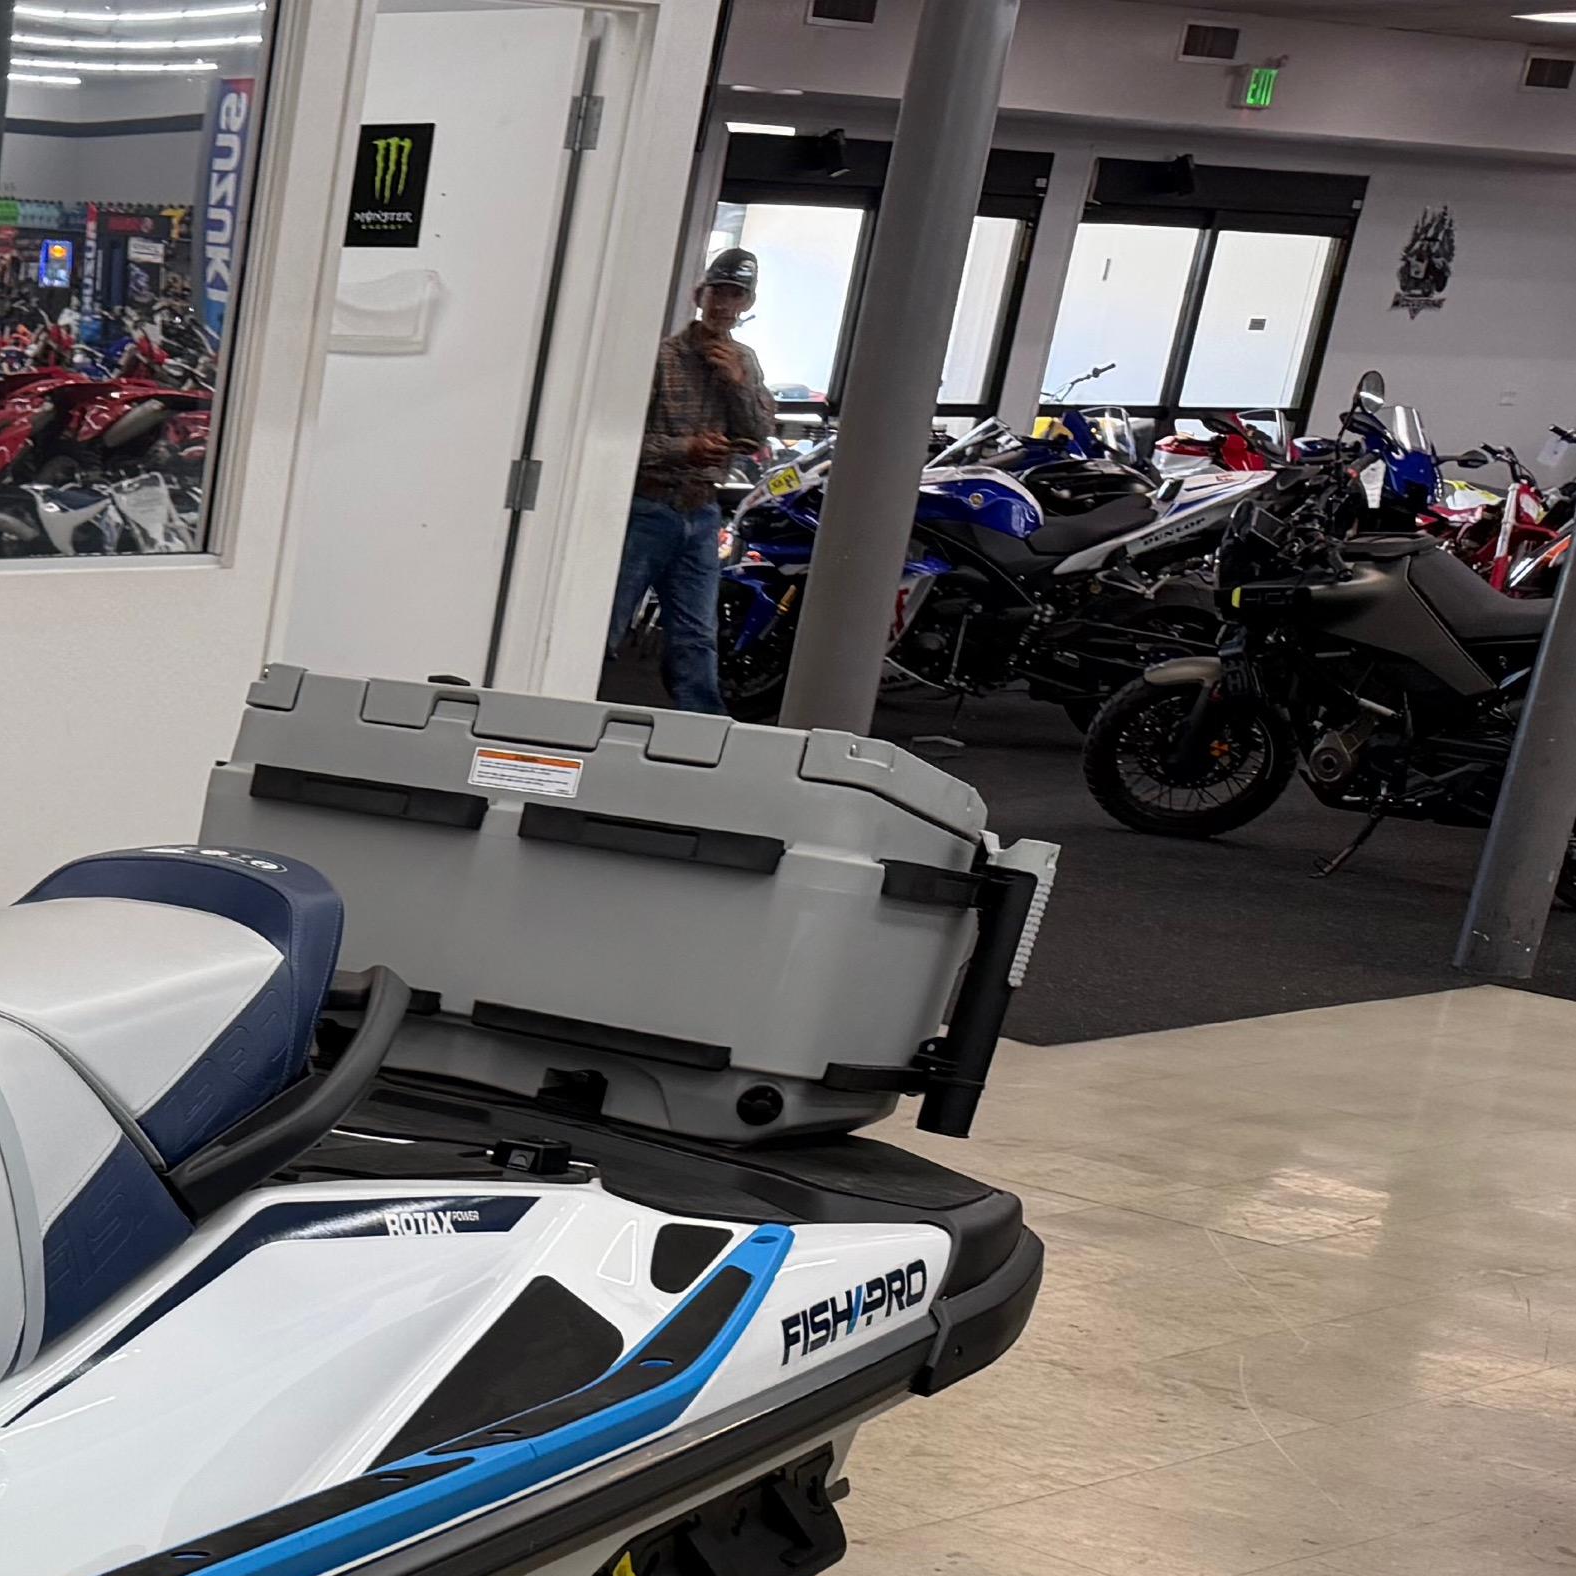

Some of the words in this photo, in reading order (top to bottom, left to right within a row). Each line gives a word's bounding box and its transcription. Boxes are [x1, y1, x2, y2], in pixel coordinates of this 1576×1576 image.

[1247, 69, 1278, 106] EXIT
[353, 209, 413, 223] MONSTER
[1143, 516, 1207, 546] DUNLOP
[384, 1211, 456, 1237] ROTAX
[452, 1210, 480, 1222] POWER
